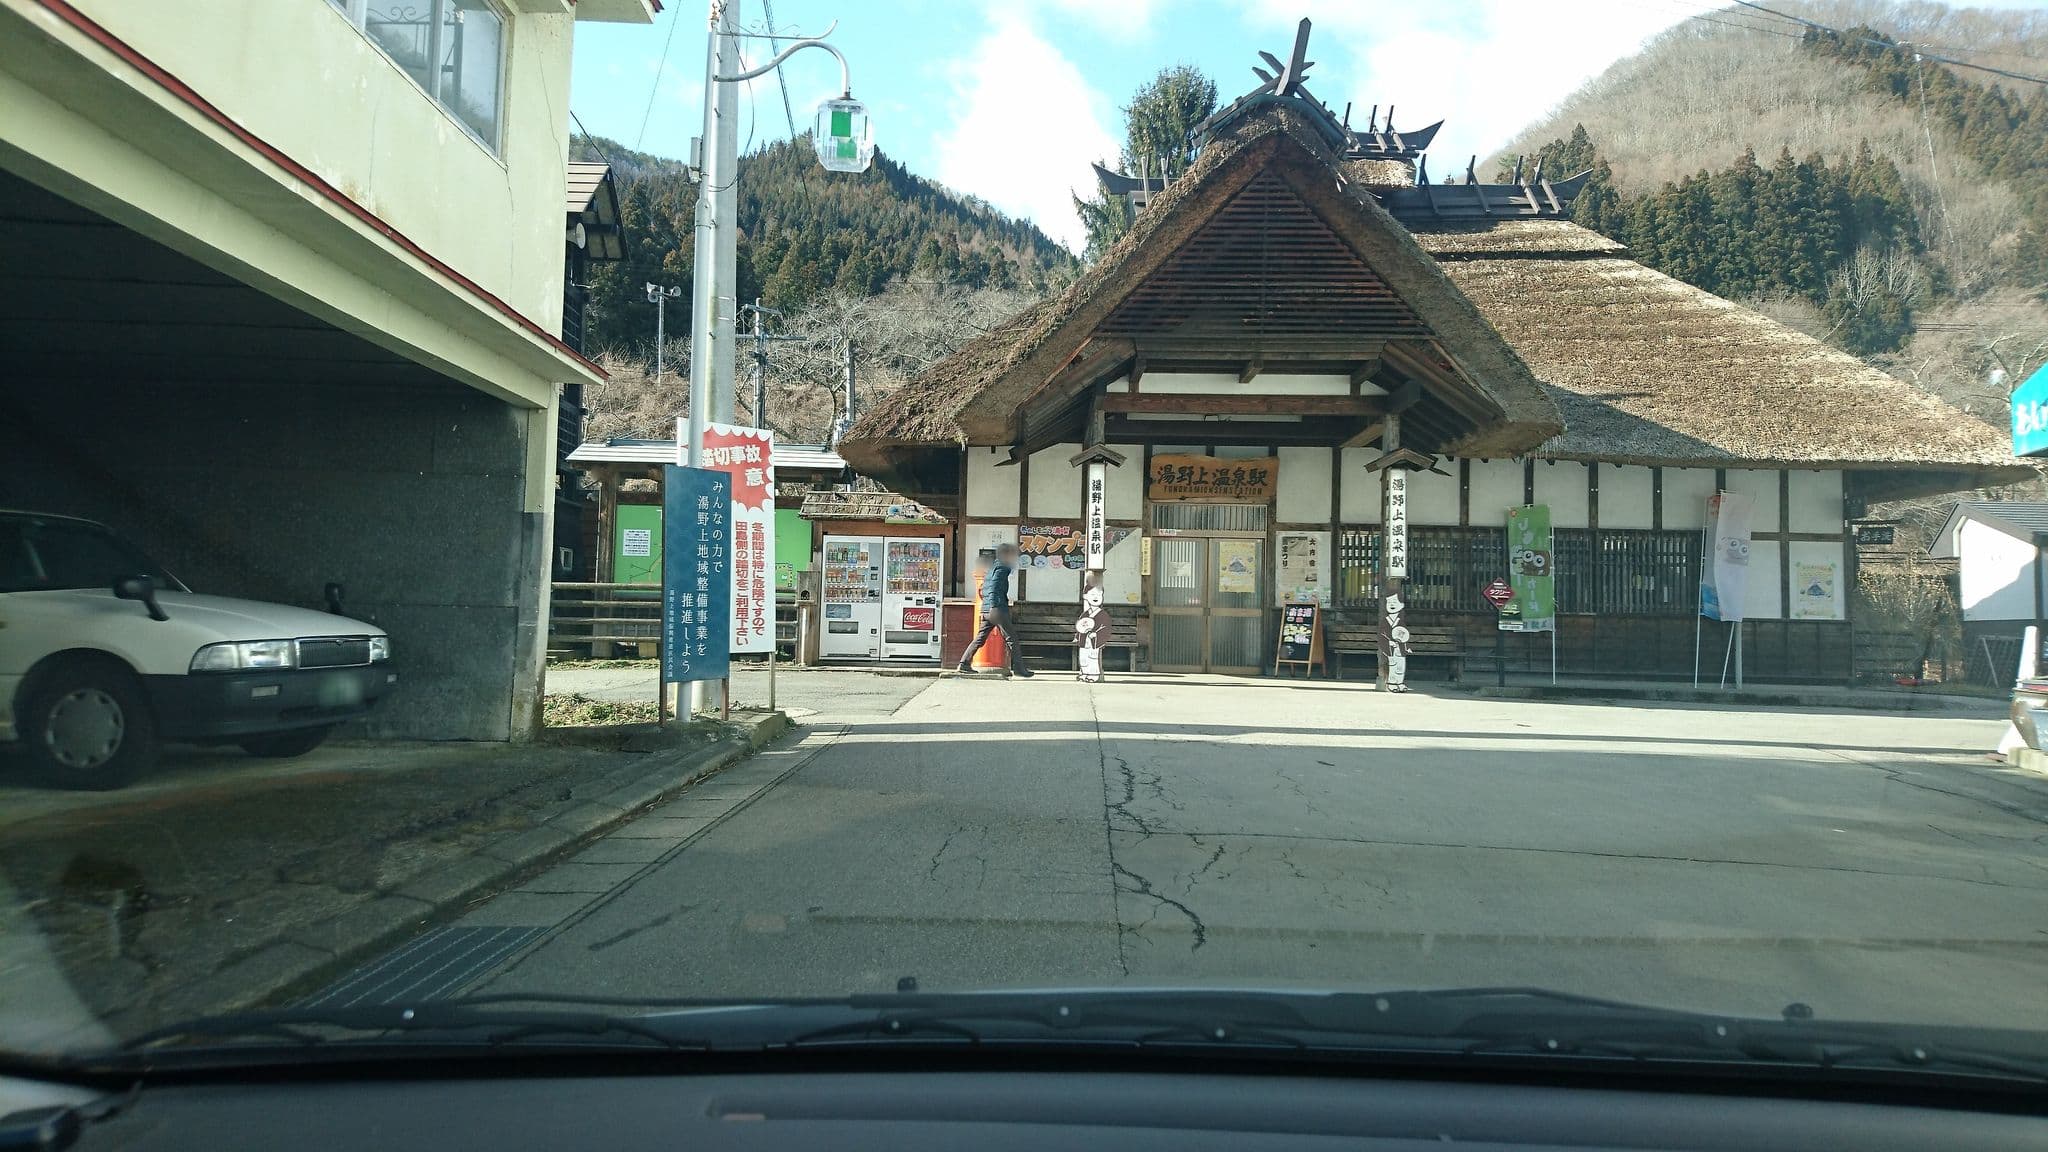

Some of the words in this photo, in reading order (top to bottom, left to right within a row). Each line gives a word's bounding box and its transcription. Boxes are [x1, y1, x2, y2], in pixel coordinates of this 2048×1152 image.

[745, 468, 765, 487] 意
[1091, 479, 1103, 555] 湯野上温泉駅
[1158, 464, 1268, 487] 湯野上温泉駅
[712, 481, 724, 573] みんなの力で
[1391, 478, 1405, 568] 湯野上温泉駅
[696, 495, 709, 656] 湯野上地域整備事業を
[736, 521, 749, 646] 田島側の踏切をご利用下さい
[752, 522, 765, 636] 冬期間は特に危険ですので
[681, 593, 694, 674] 推進しよう
